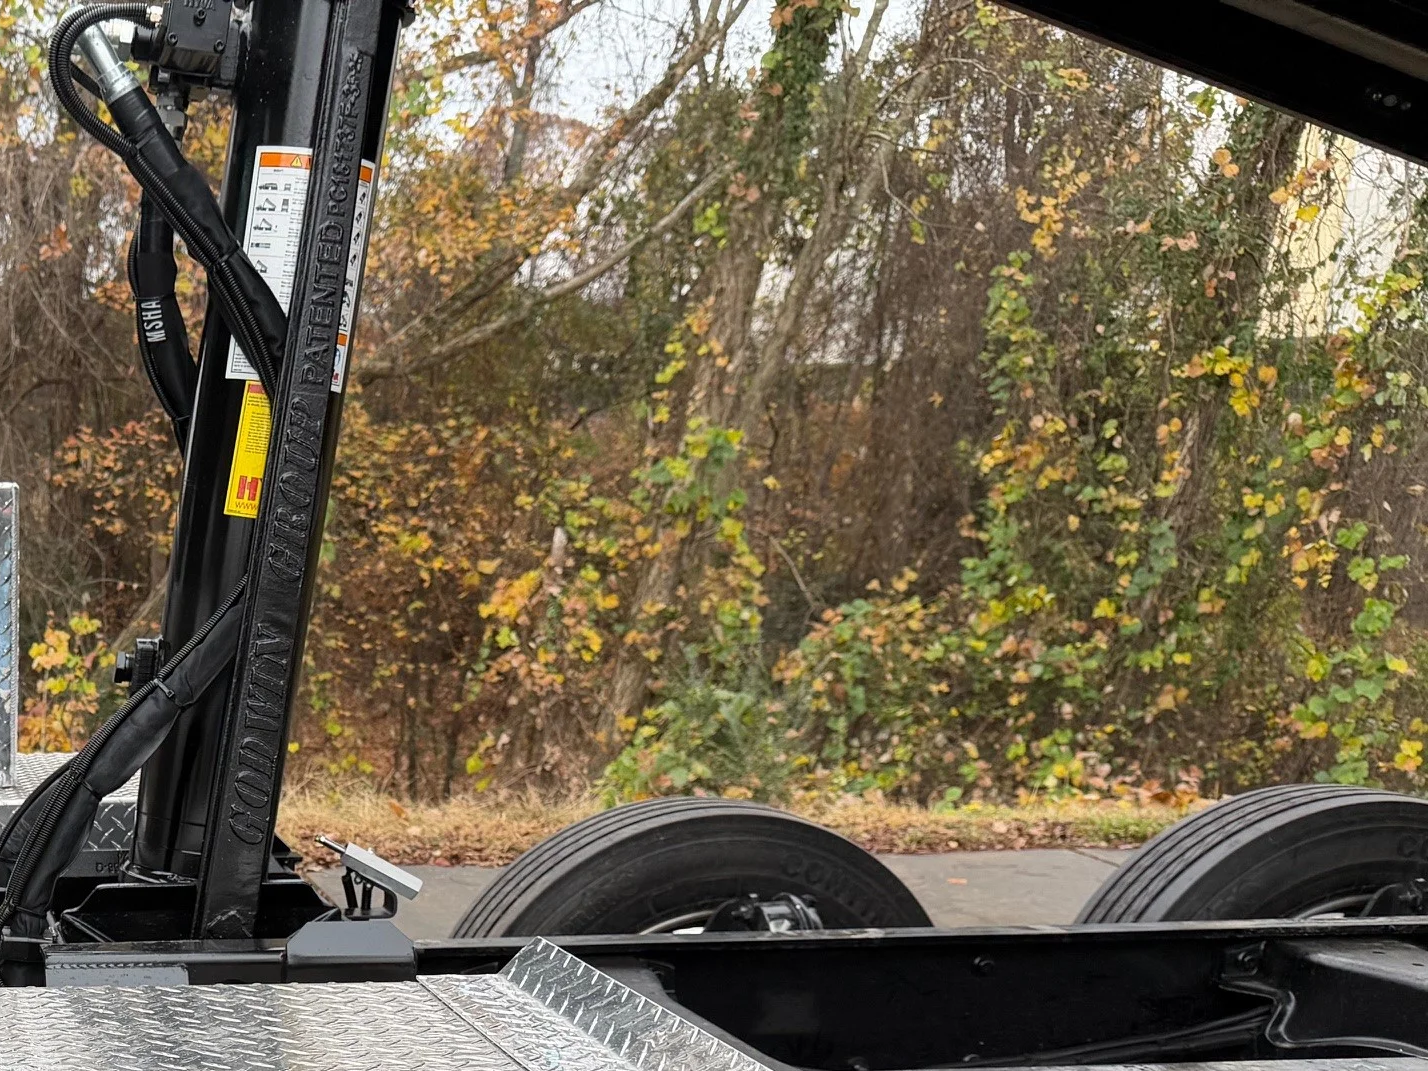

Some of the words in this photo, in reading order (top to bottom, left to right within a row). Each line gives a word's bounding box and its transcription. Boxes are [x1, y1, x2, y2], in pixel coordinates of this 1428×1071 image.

[140, 298, 167, 343] MSHA
[299, 220, 344, 386] PATENTED
[268, 397, 324, 583] GROUP
[228, 624, 294, 846] GODWIN
